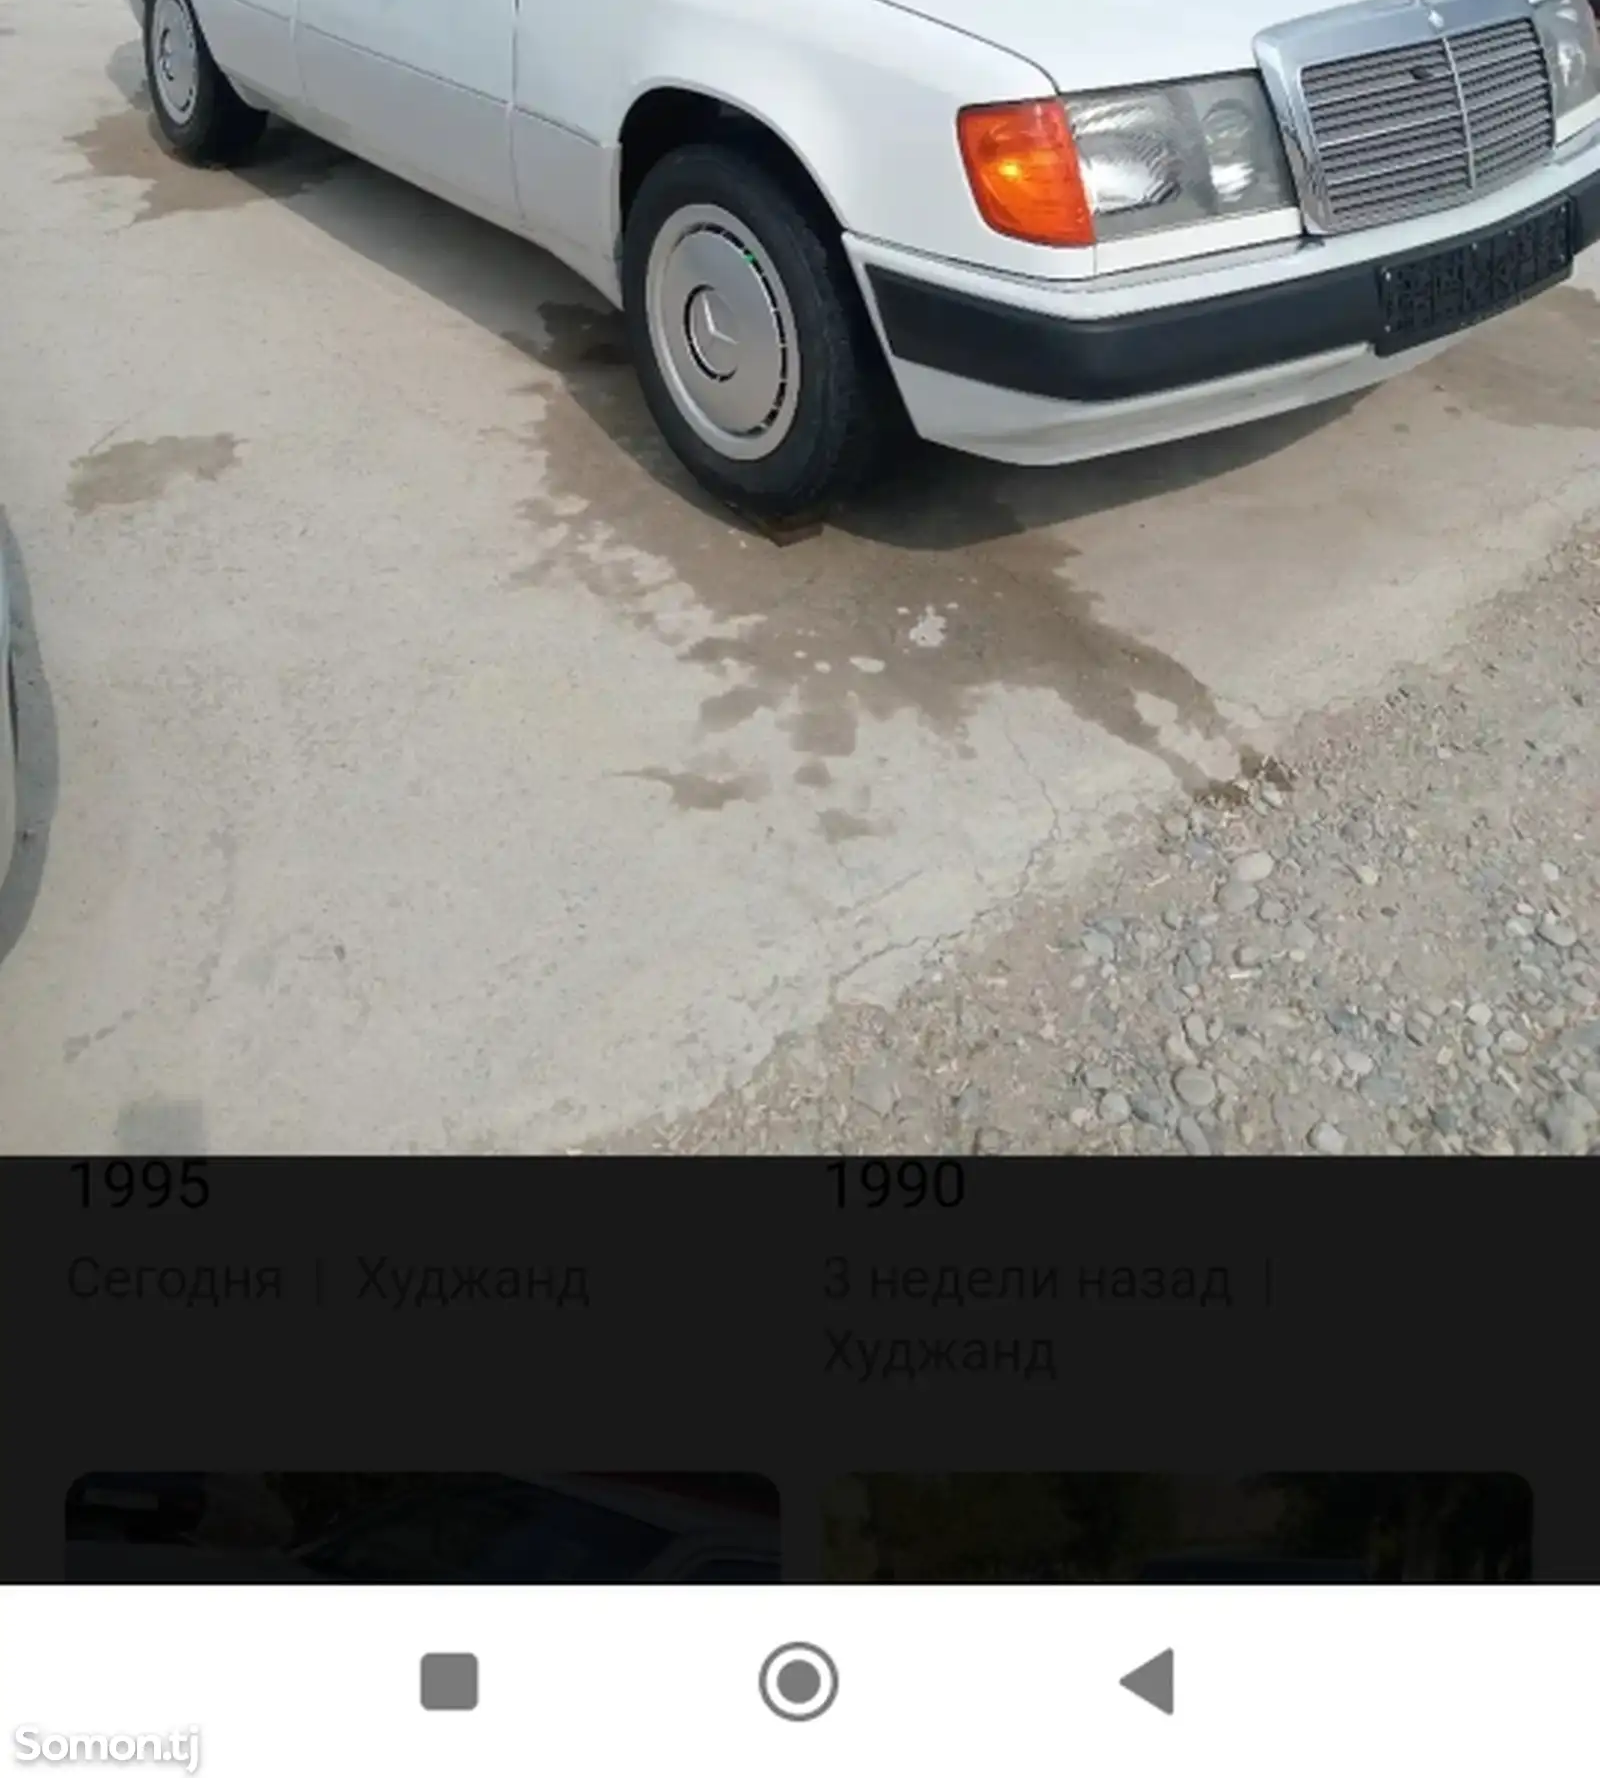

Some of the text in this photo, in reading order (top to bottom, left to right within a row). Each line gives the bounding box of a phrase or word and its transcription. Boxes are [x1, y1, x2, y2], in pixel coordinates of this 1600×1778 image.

[68, 1158, 211, 1210] 1995
[825, 1158, 967, 1210] 1990
[67, 1256, 591, 1310] Сегодня Худжанд
[823, 1256, 1233, 1309] 3 недели назад
[824, 1329, 1058, 1384] Худжанд
